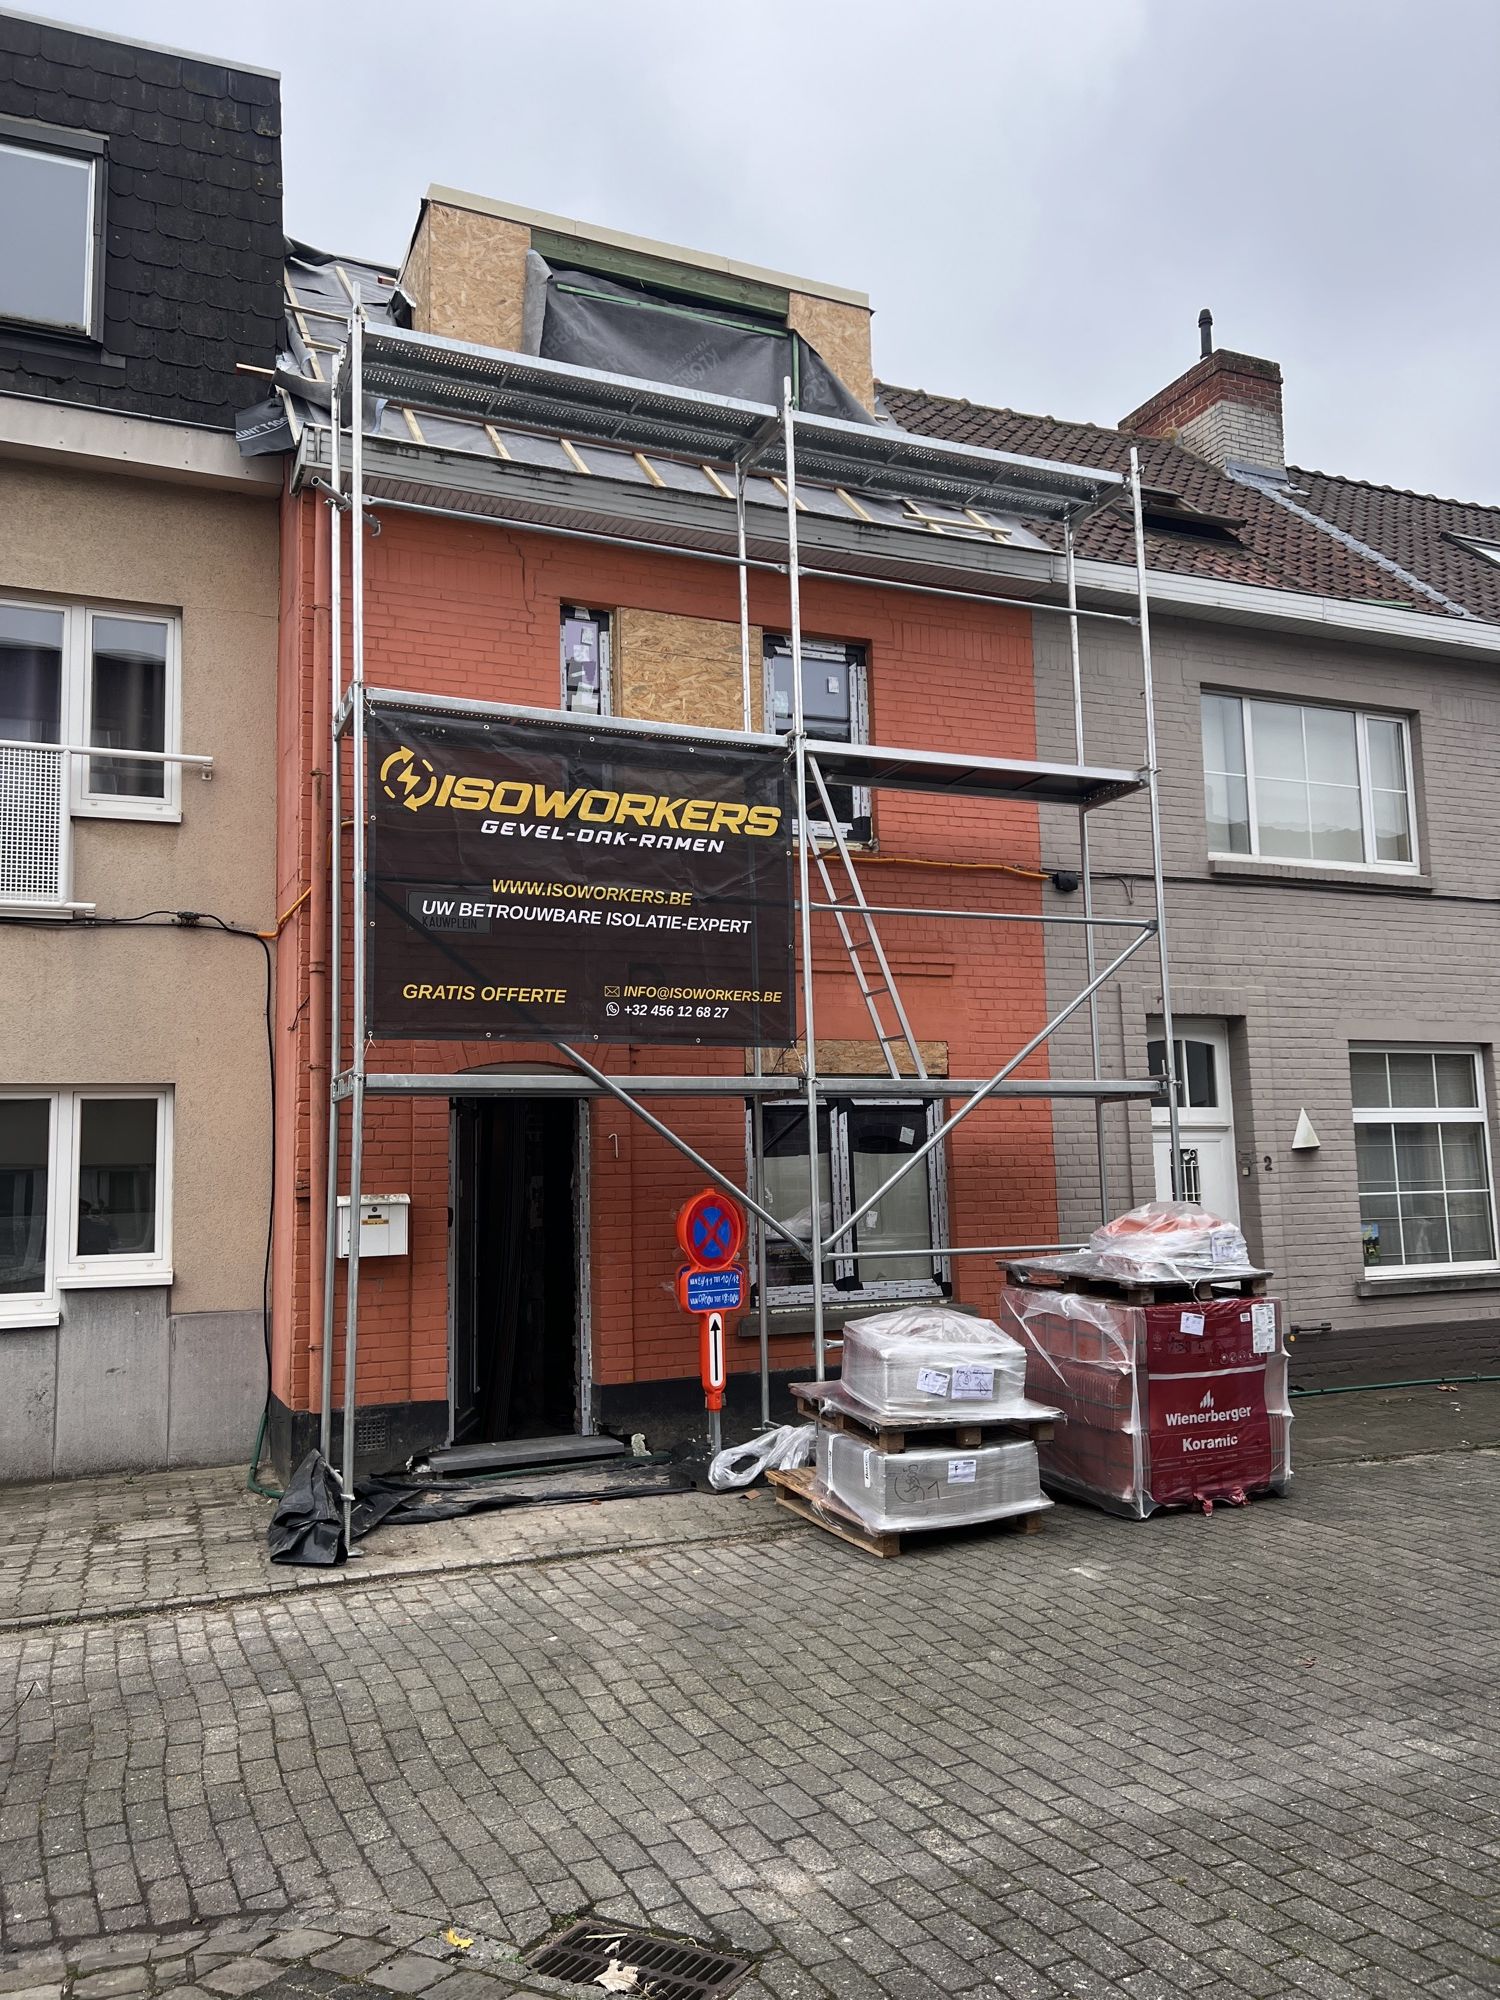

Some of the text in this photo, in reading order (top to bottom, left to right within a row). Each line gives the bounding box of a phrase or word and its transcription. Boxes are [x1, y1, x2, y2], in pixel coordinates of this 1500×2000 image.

[434, 775, 782, 838] ISOWORKERS
[480, 820, 725, 854] GEVEL-DAK-RAMEN
[492, 878, 693, 906] WWW.ISOWORKERS.BE
[422, 900, 752, 934] UW BETROUWBARE ISOLATIE-EXPERT
[402, 984, 567, 1004] GRATIS OFFERTE
[623, 985, 783, 1003] INFO@ISOWORKERS.BE
[624, 1004, 729, 1019] +32 456 12 68 27
[1264, 1155, 1272, 1171] 2
[1165, 1406, 1251, 1427] Wienerberger
[1182, 1434, 1238, 1452] Koramic
